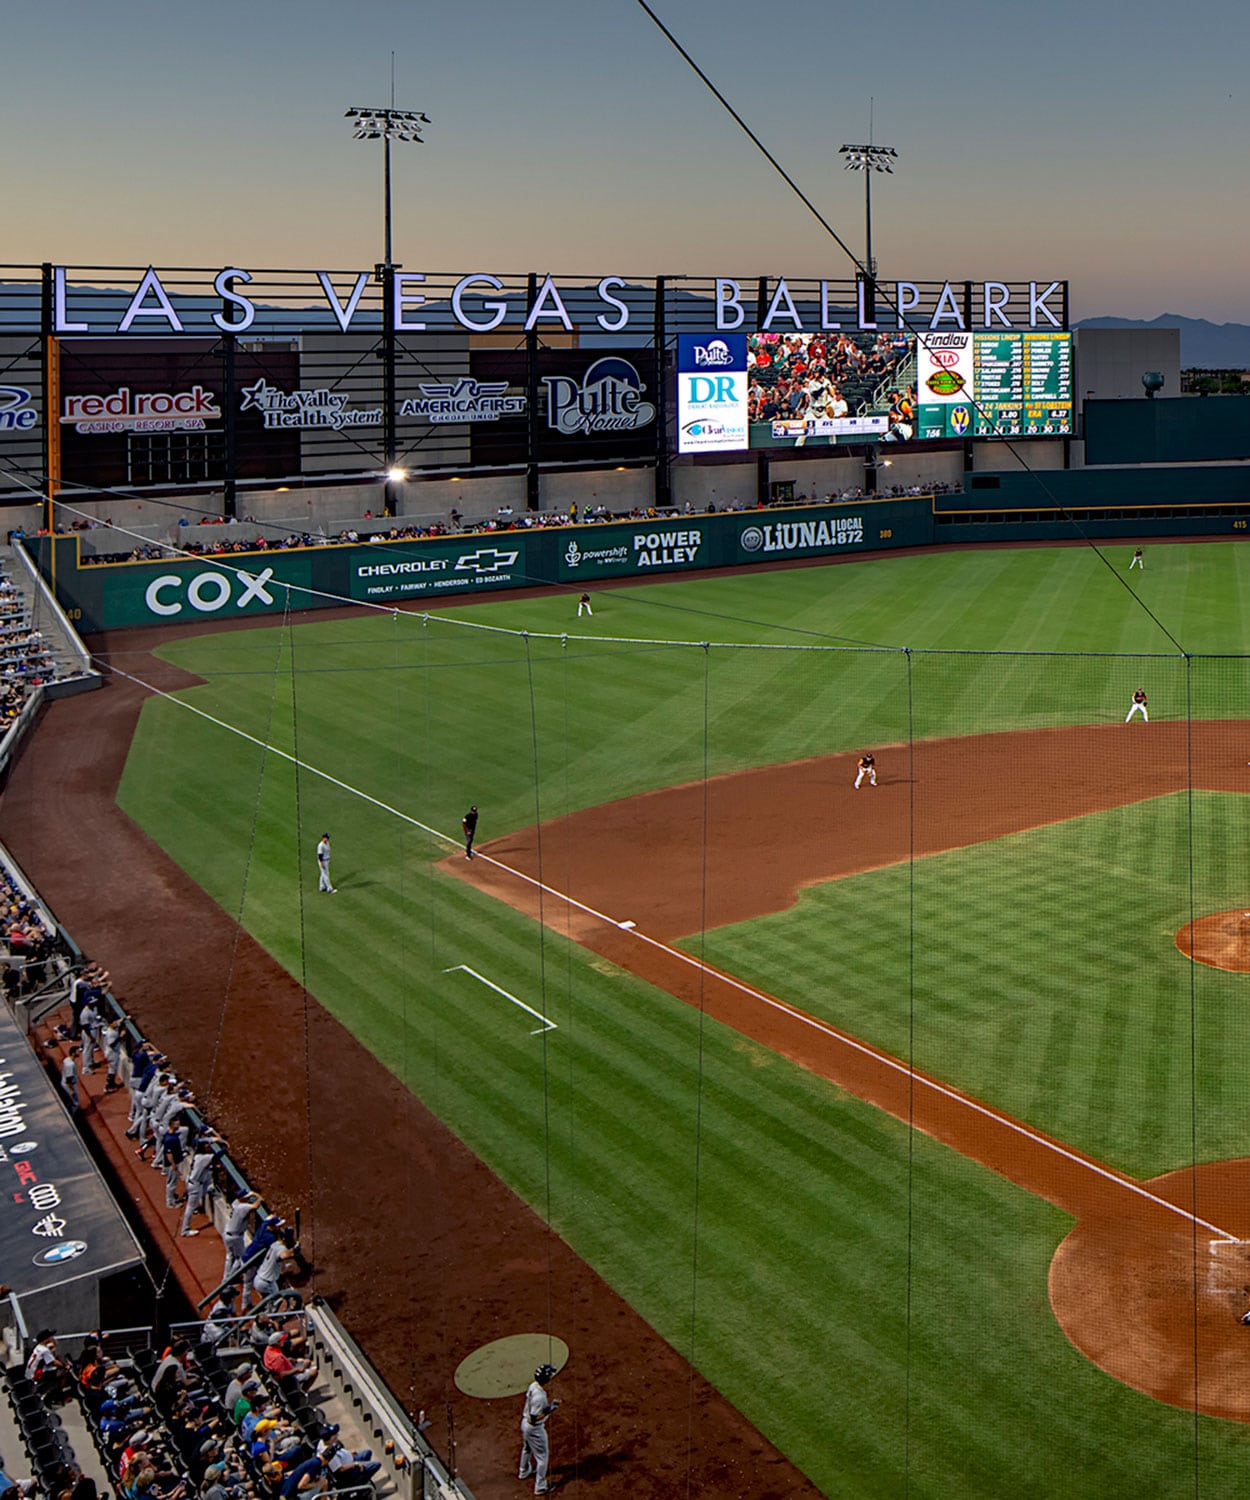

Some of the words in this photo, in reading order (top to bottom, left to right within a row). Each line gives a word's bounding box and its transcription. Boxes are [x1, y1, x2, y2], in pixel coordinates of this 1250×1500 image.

[55, 263, 257, 332] LAS
[316, 271, 631, 333] VEGAS
[715, 277, 1063, 331] BALLPARK
[924, 333, 969, 348] Findlay
[693, 346, 731, 365] Pulte
[936, 354, 955, 364] KIA
[687, 375, 740, 405] DR
[66, 386, 130, 418] red
[134, 386, 214, 416] rock
[265, 389, 297, 410] The
[292, 389, 349, 412] Valley
[401, 399, 478, 415] AMERICA
[479, 397, 527, 413] FIRST
[541, 376, 641, 430] Pulte
[76, 421, 126, 433] CASINO
[135, 420, 177, 431] RESORT
[184, 418, 206, 430] SPA
[264, 410, 330, 429] Health
[329, 409, 383, 431] System
[431, 414, 467, 422] CREDIT
[470, 413, 500, 421] UNION
[566, 408, 646, 434] Homes
[836, 517, 863, 531] LOCAL
[1232, 520, 1247, 528] 415
[633, 531, 702, 551] POWER
[762, 519, 837, 552] LiUNA!
[836, 530, 864, 544] 872
[582, 546, 628, 561] powershift
[637, 547, 698, 567] ALLEY
[358, 559, 449, 578] CHEVROLET
[145, 567, 275, 616] COX
[367, 585, 394, 595] FINDLAY
[400, 582, 428, 591] FAIRWAY
[433, 578, 470, 589] HENDERSON
[475, 577, 484, 585] ED
[484, 574, 512, 584] BOZARTH
[13, 1159, 38, 1186] GMC
